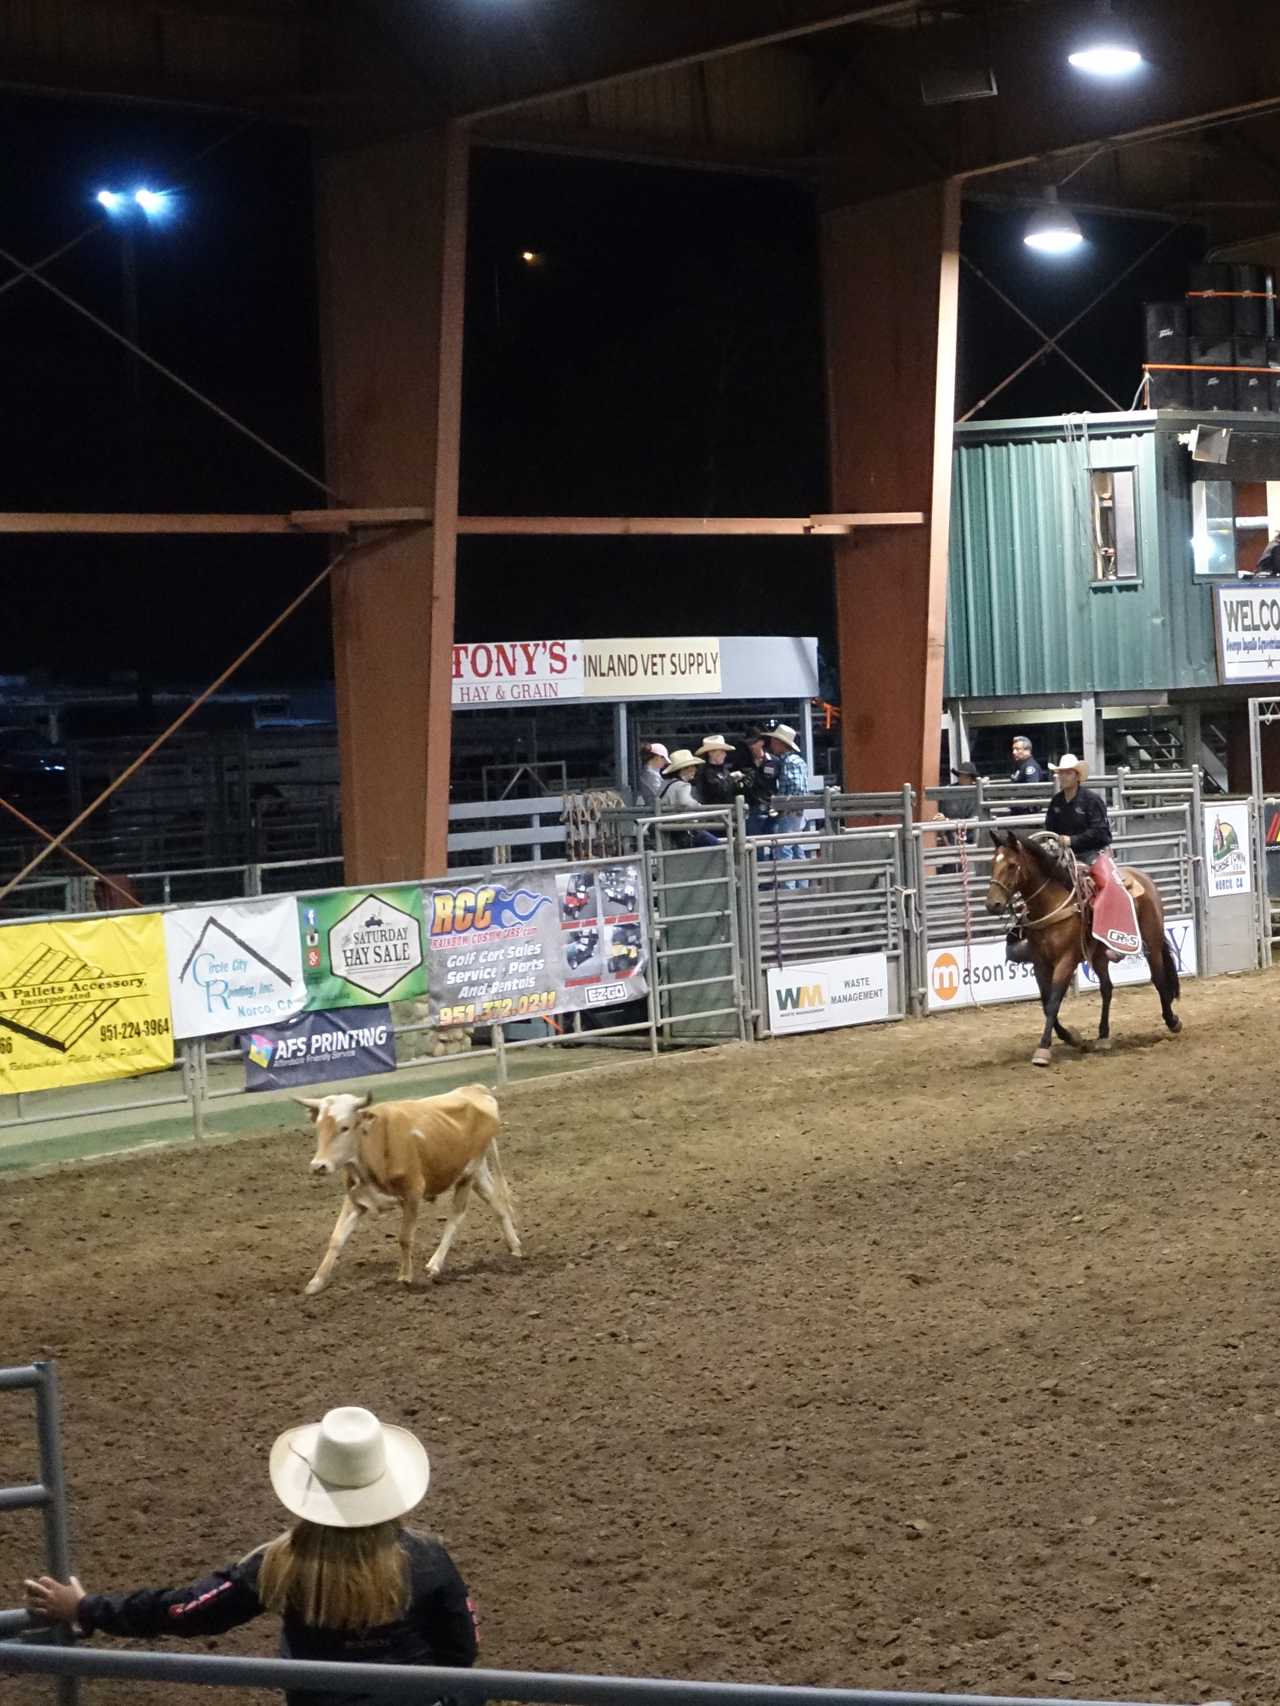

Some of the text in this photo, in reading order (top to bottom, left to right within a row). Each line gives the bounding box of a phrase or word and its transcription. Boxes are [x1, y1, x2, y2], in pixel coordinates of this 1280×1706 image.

[452, 641, 568, 679] TONY'S
[583, 652, 719, 677] INLAND VET SUPPLY
[460, 682, 559, 702] HAY & GRAIN
[353, 927, 409, 945] SATURDAY
[342, 943, 410, 967] HAY SALE
[446, 943, 543, 968] Golf Cart Sales
[446, 959, 545, 985] Service Parts
[844, 977, 871, 989] WASTE
[13, 985, 65, 1000] Pallets
[20, 991, 91, 1007] Incorporated
[458, 983, 489, 999] And
[776, 984, 826, 1011] WM
[831, 989, 884, 1005] MANAGEMENT
[100, 1017, 169, 1043] 951-224-3964
[274, 1026, 388, 1060] AFS PRINTING
